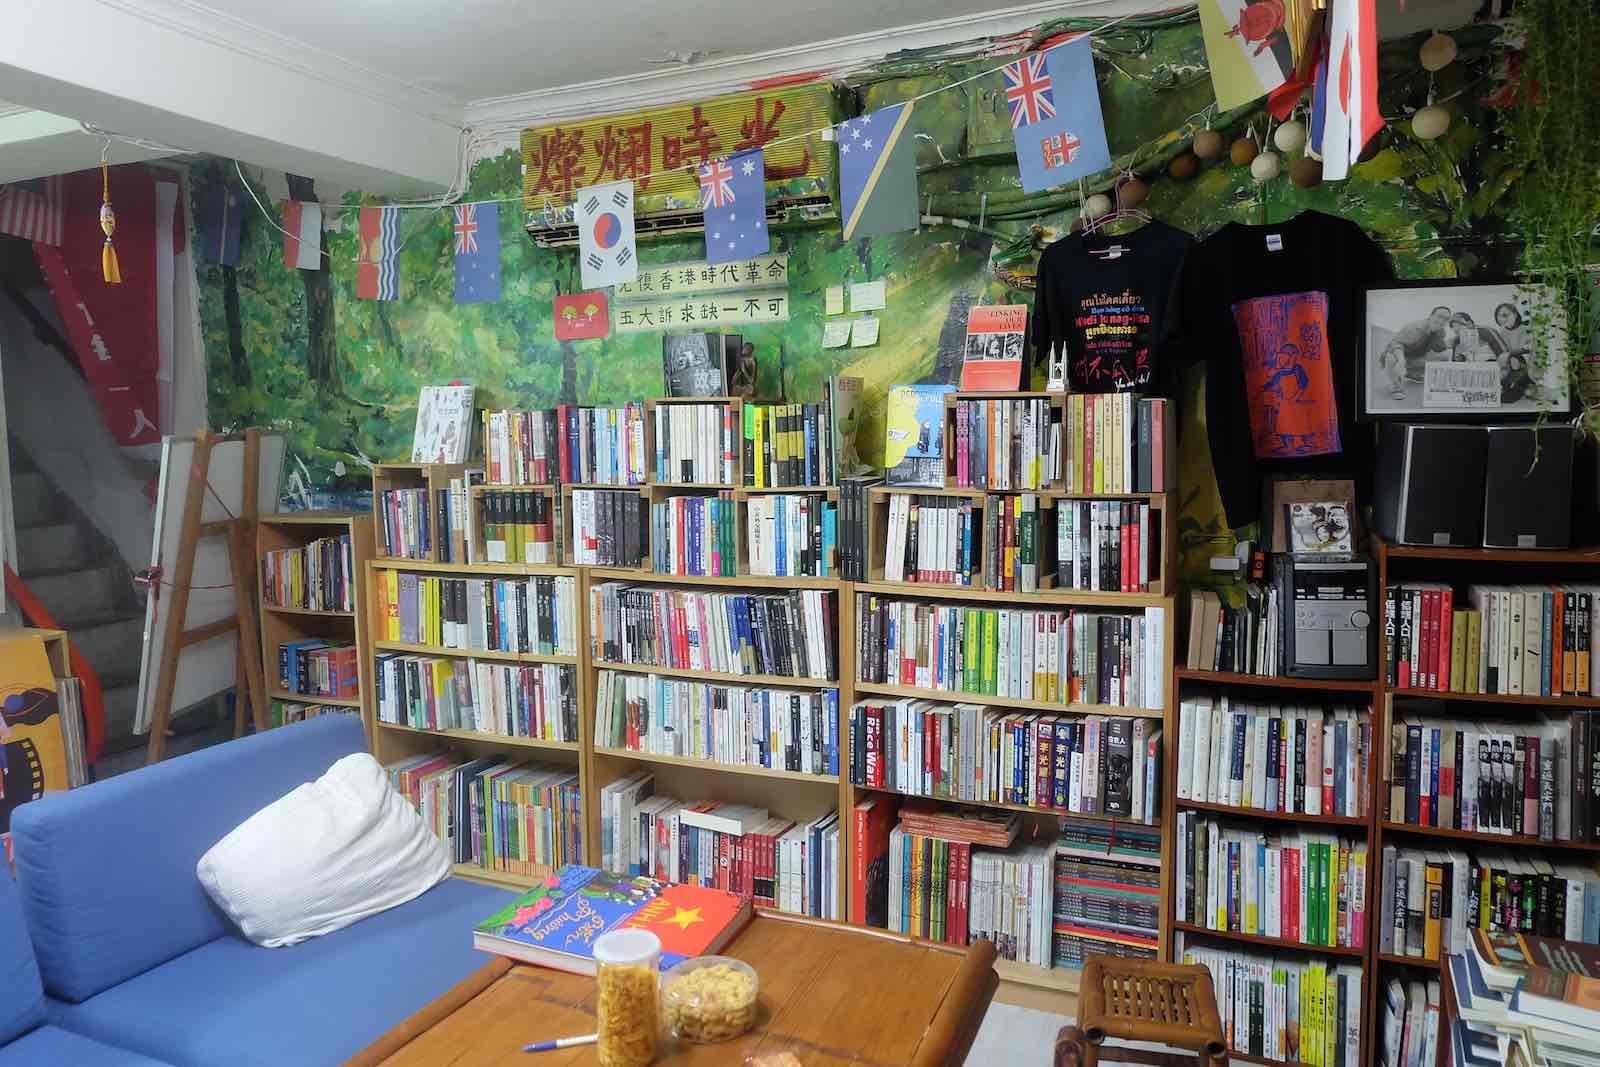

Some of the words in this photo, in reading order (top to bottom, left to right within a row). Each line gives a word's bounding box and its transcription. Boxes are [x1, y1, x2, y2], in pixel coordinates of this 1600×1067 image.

[619, 298, 785, 326] 五大訴求缺一不可
[867, 717, 876, 749] Race
[867, 751, 877, 787] War!
